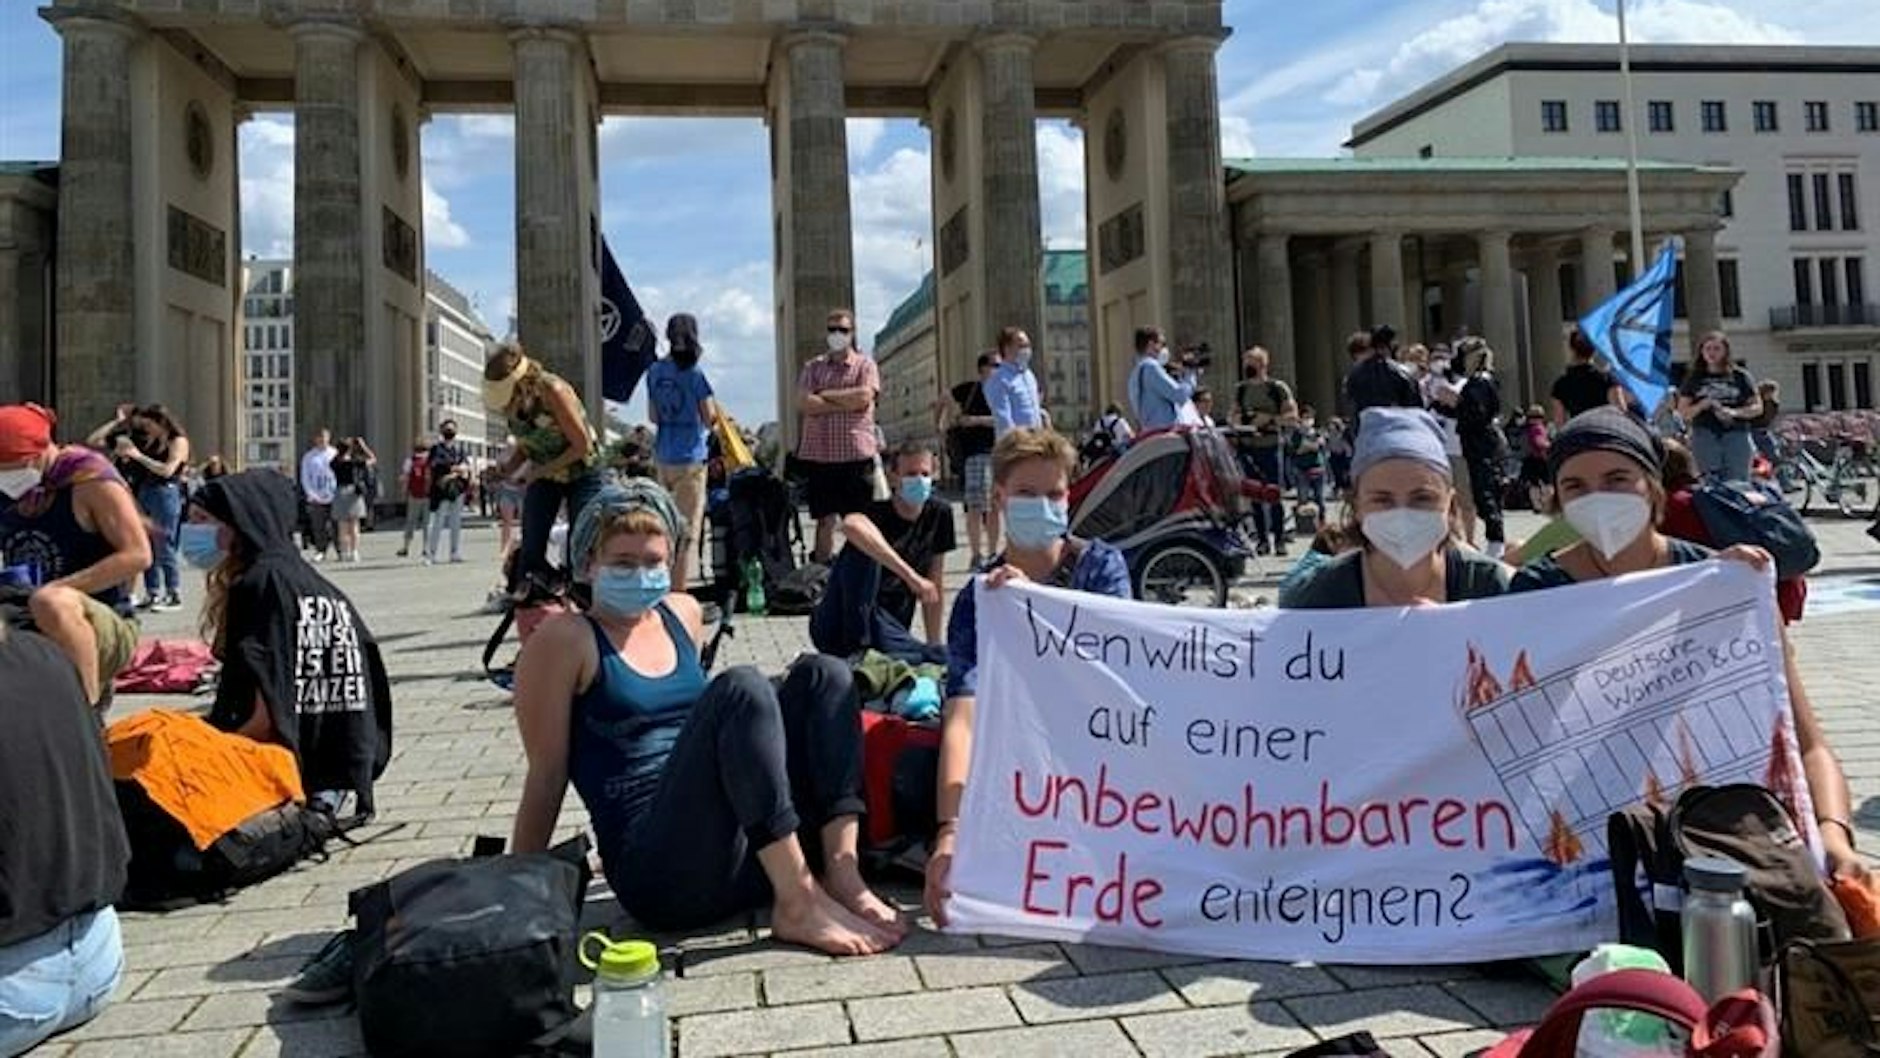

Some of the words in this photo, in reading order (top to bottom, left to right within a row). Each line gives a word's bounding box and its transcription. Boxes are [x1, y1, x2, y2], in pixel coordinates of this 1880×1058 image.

[1026, 598, 1131, 666] Wen
[1141, 626, 1264, 678] willst
[1285, 630, 1345, 681] du
[1603, 659, 1706, 710] Wohnen
[1708, 647, 1728, 668] &
[1729, 637, 1762, 661] Co
[1088, 705, 1157, 747] auf
[1186, 718, 1327, 762] einer
[1014, 765, 1517, 851] unbewohnbaren
[1022, 841, 1164, 928] Erde
[1200, 872, 1473, 943] enteignen?
